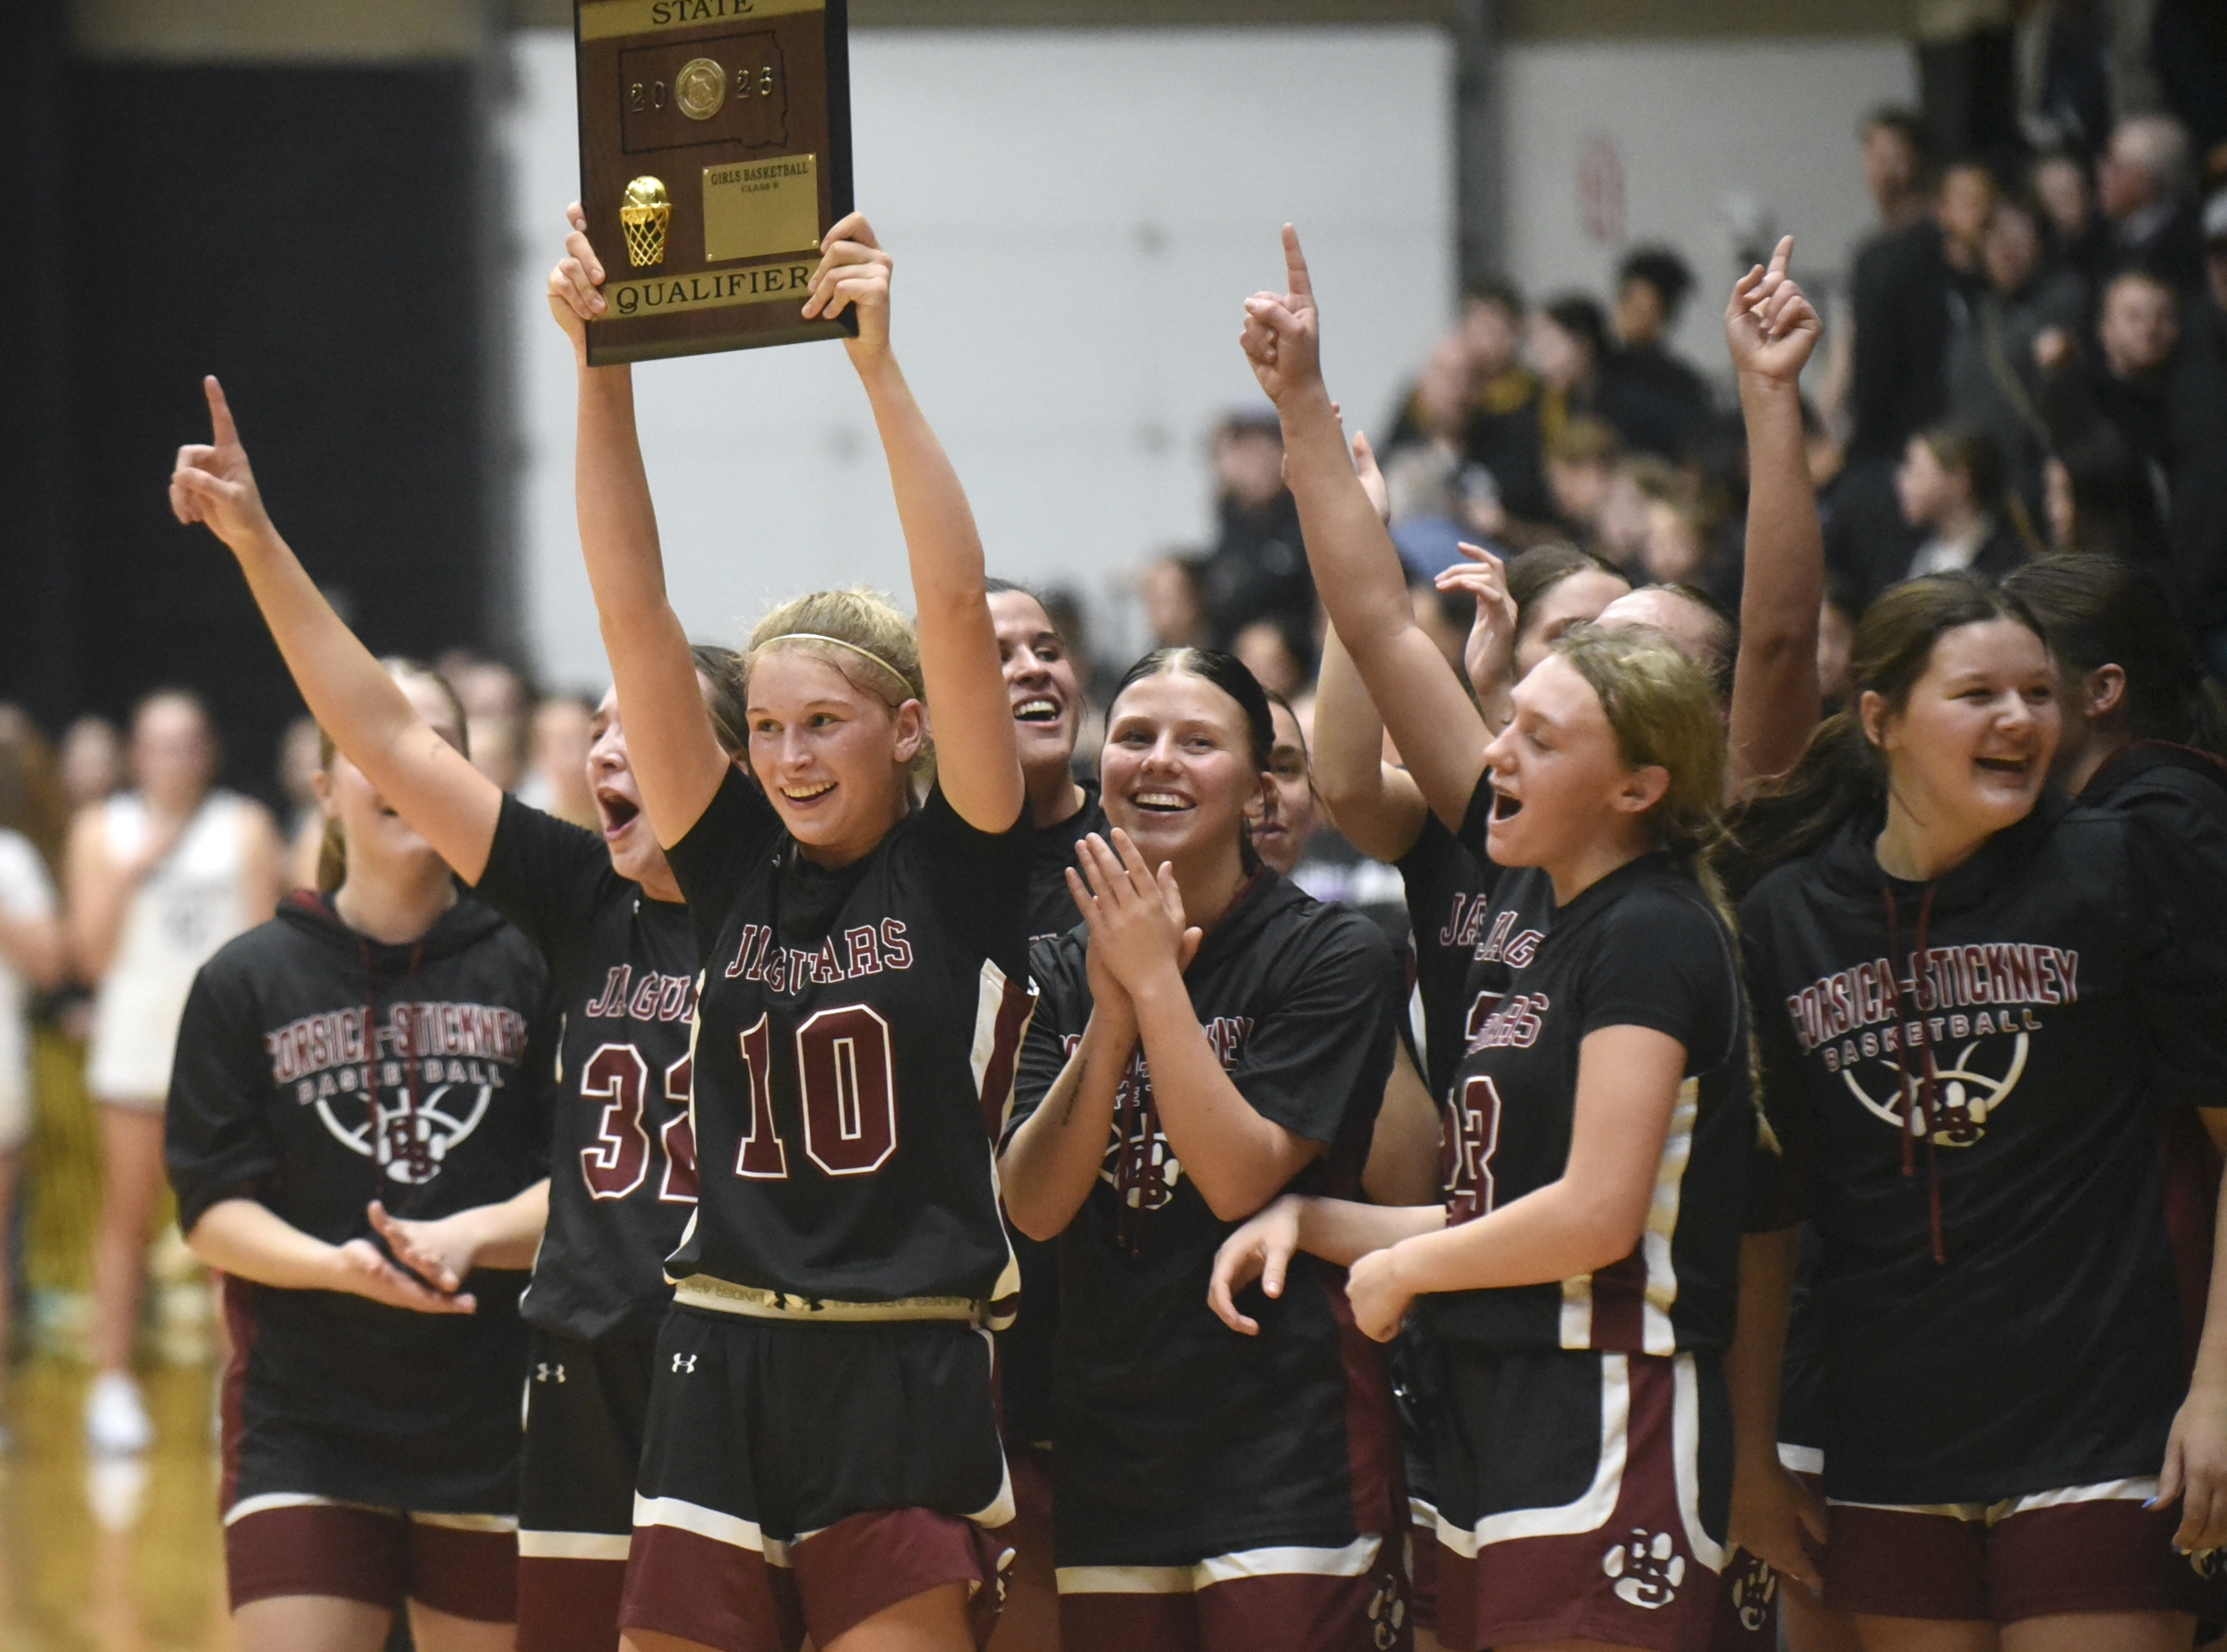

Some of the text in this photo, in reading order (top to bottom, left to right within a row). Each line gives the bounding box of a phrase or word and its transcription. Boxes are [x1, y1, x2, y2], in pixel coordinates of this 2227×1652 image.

[652, 0, 753, 24] STATE
[710, 161, 809, 185] GIRLS BASKETBALL
[741, 183, 770, 194] CLASS
[616, 266, 809, 314] QUALIFIER
[725, 916, 914, 996] JAGUARS
[1823, 1008, 2043, 1072] BASKETBALL
[735, 1003, 897, 1178] 10
